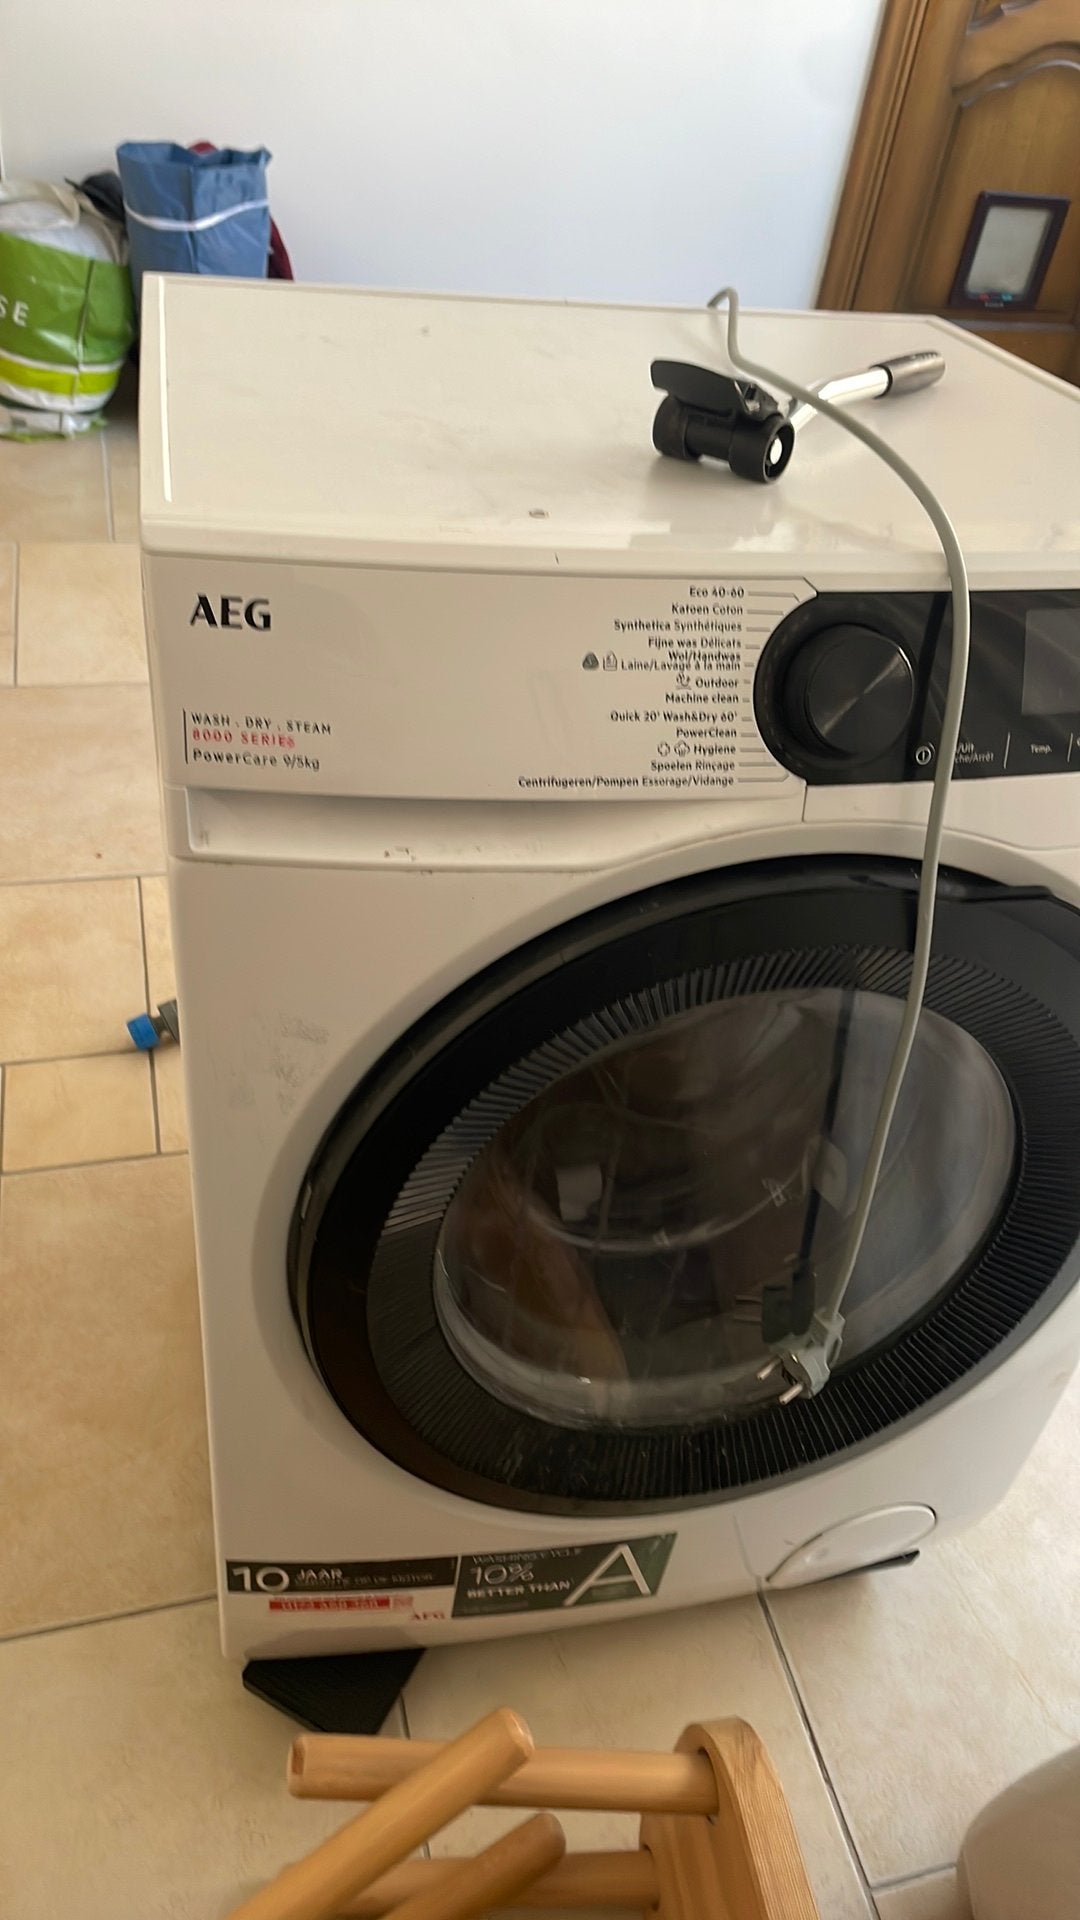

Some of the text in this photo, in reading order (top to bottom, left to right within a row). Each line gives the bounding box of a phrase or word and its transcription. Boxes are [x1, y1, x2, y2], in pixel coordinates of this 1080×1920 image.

[689, 585, 745, 599] Eco 40-60
[190, 592, 271, 631] AEG
[671, 602, 743, 616] Katoen Coton
[614, 619, 742, 633] Synthetica Synthétiques
[648, 636, 742, 650] Fijne was Délicats
[668, 651, 741, 663] Wol/Handwas
[621, 659, 741, 672] Laine/Lavage à la main
[695, 677, 739, 688] Outdoor
[665, 692, 739, 704] Machine clean
[191, 712, 332, 735] WASH DRY STEAM
[610, 710, 640, 722] Quick
[663, 711, 716, 724] Wash&Dry
[192, 727, 296, 748] 8000 SERIES
[676, 727, 737, 739] PowerClean
[693, 744, 736, 757] Hygiene
[956, 743, 975, 754] /Uit
[1030, 743, 1053, 755] Temp.
[193, 748, 320, 772] PowerCare 9/5kg
[954, 752, 994, 764] che/Arrêt
[651, 760, 735, 773] Spoelen Rinçage
[518, 775, 734, 789] Centrifugeren/Pompen Essorage/Vidange
[232, 1566, 290, 1592] 10
[299, 1567, 344, 1581] JAAR
[470, 1562, 534, 1586] 10%
[562, 1543, 651, 1607] A
[466, 1579, 571, 1600] BETTER THAN
